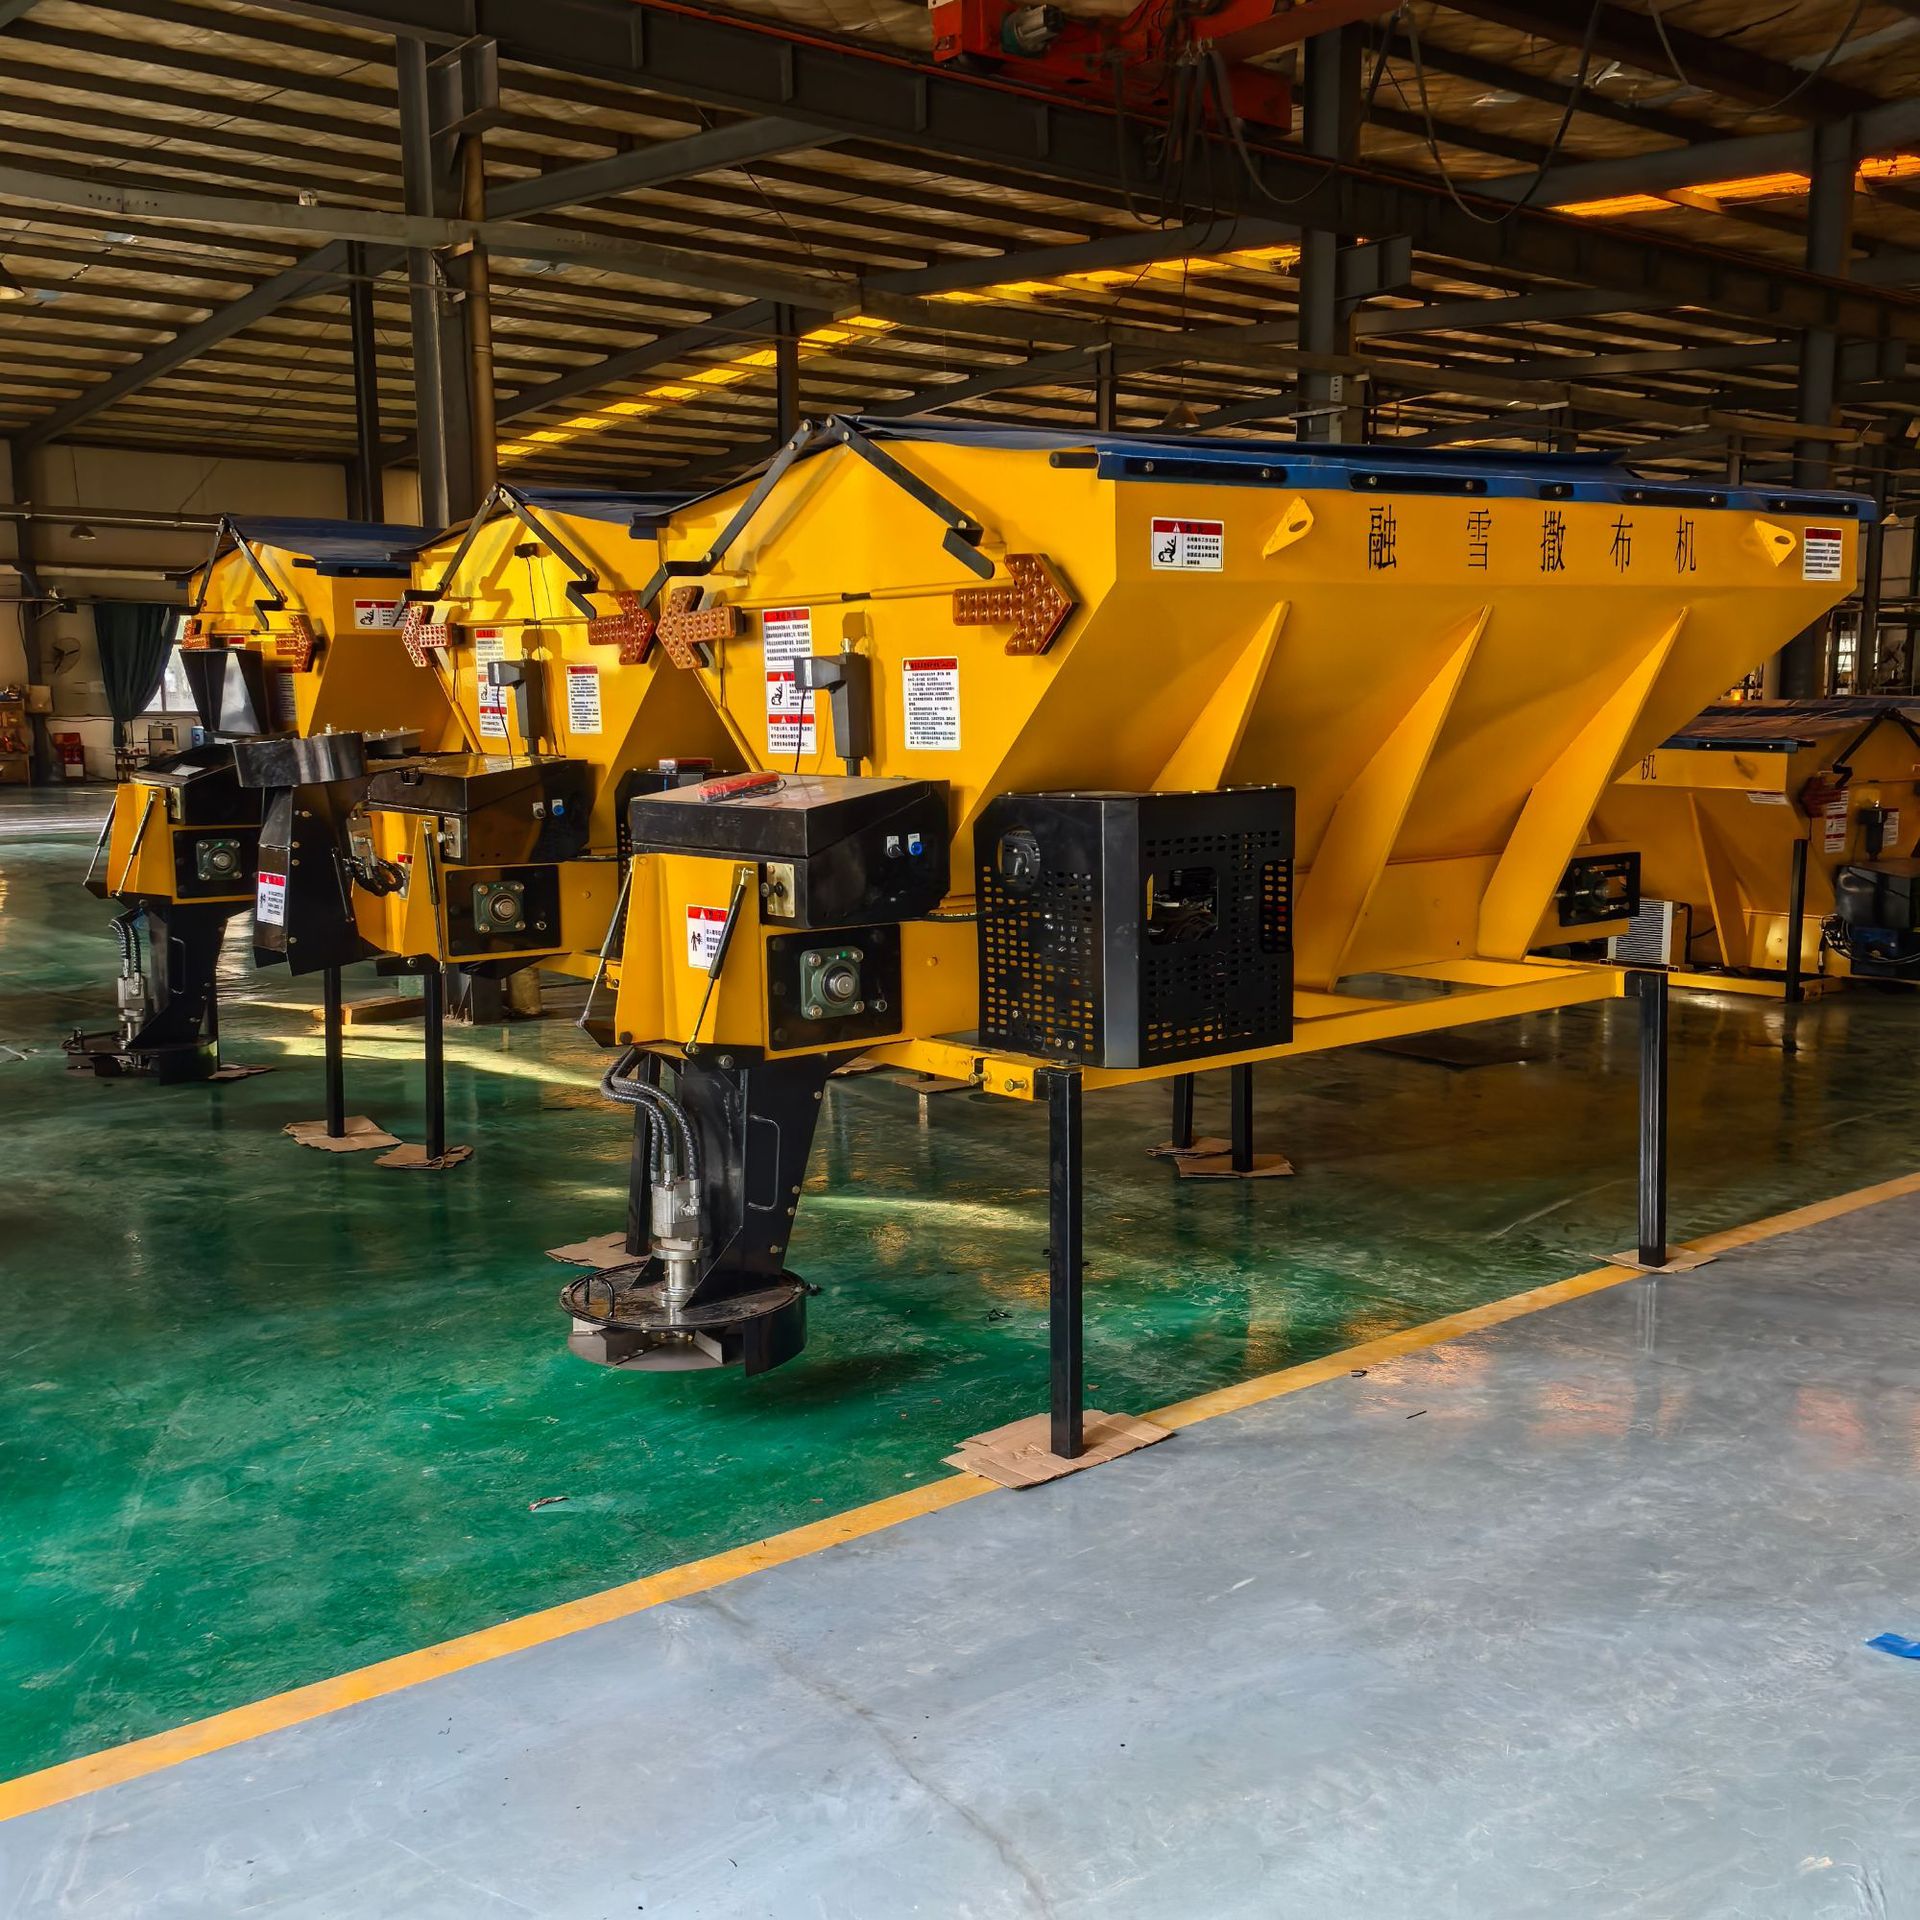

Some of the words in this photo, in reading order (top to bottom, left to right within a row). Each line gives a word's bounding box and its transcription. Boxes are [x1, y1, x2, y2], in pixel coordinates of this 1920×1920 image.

[1368, 504, 1697, 574] 融雪撒布机
